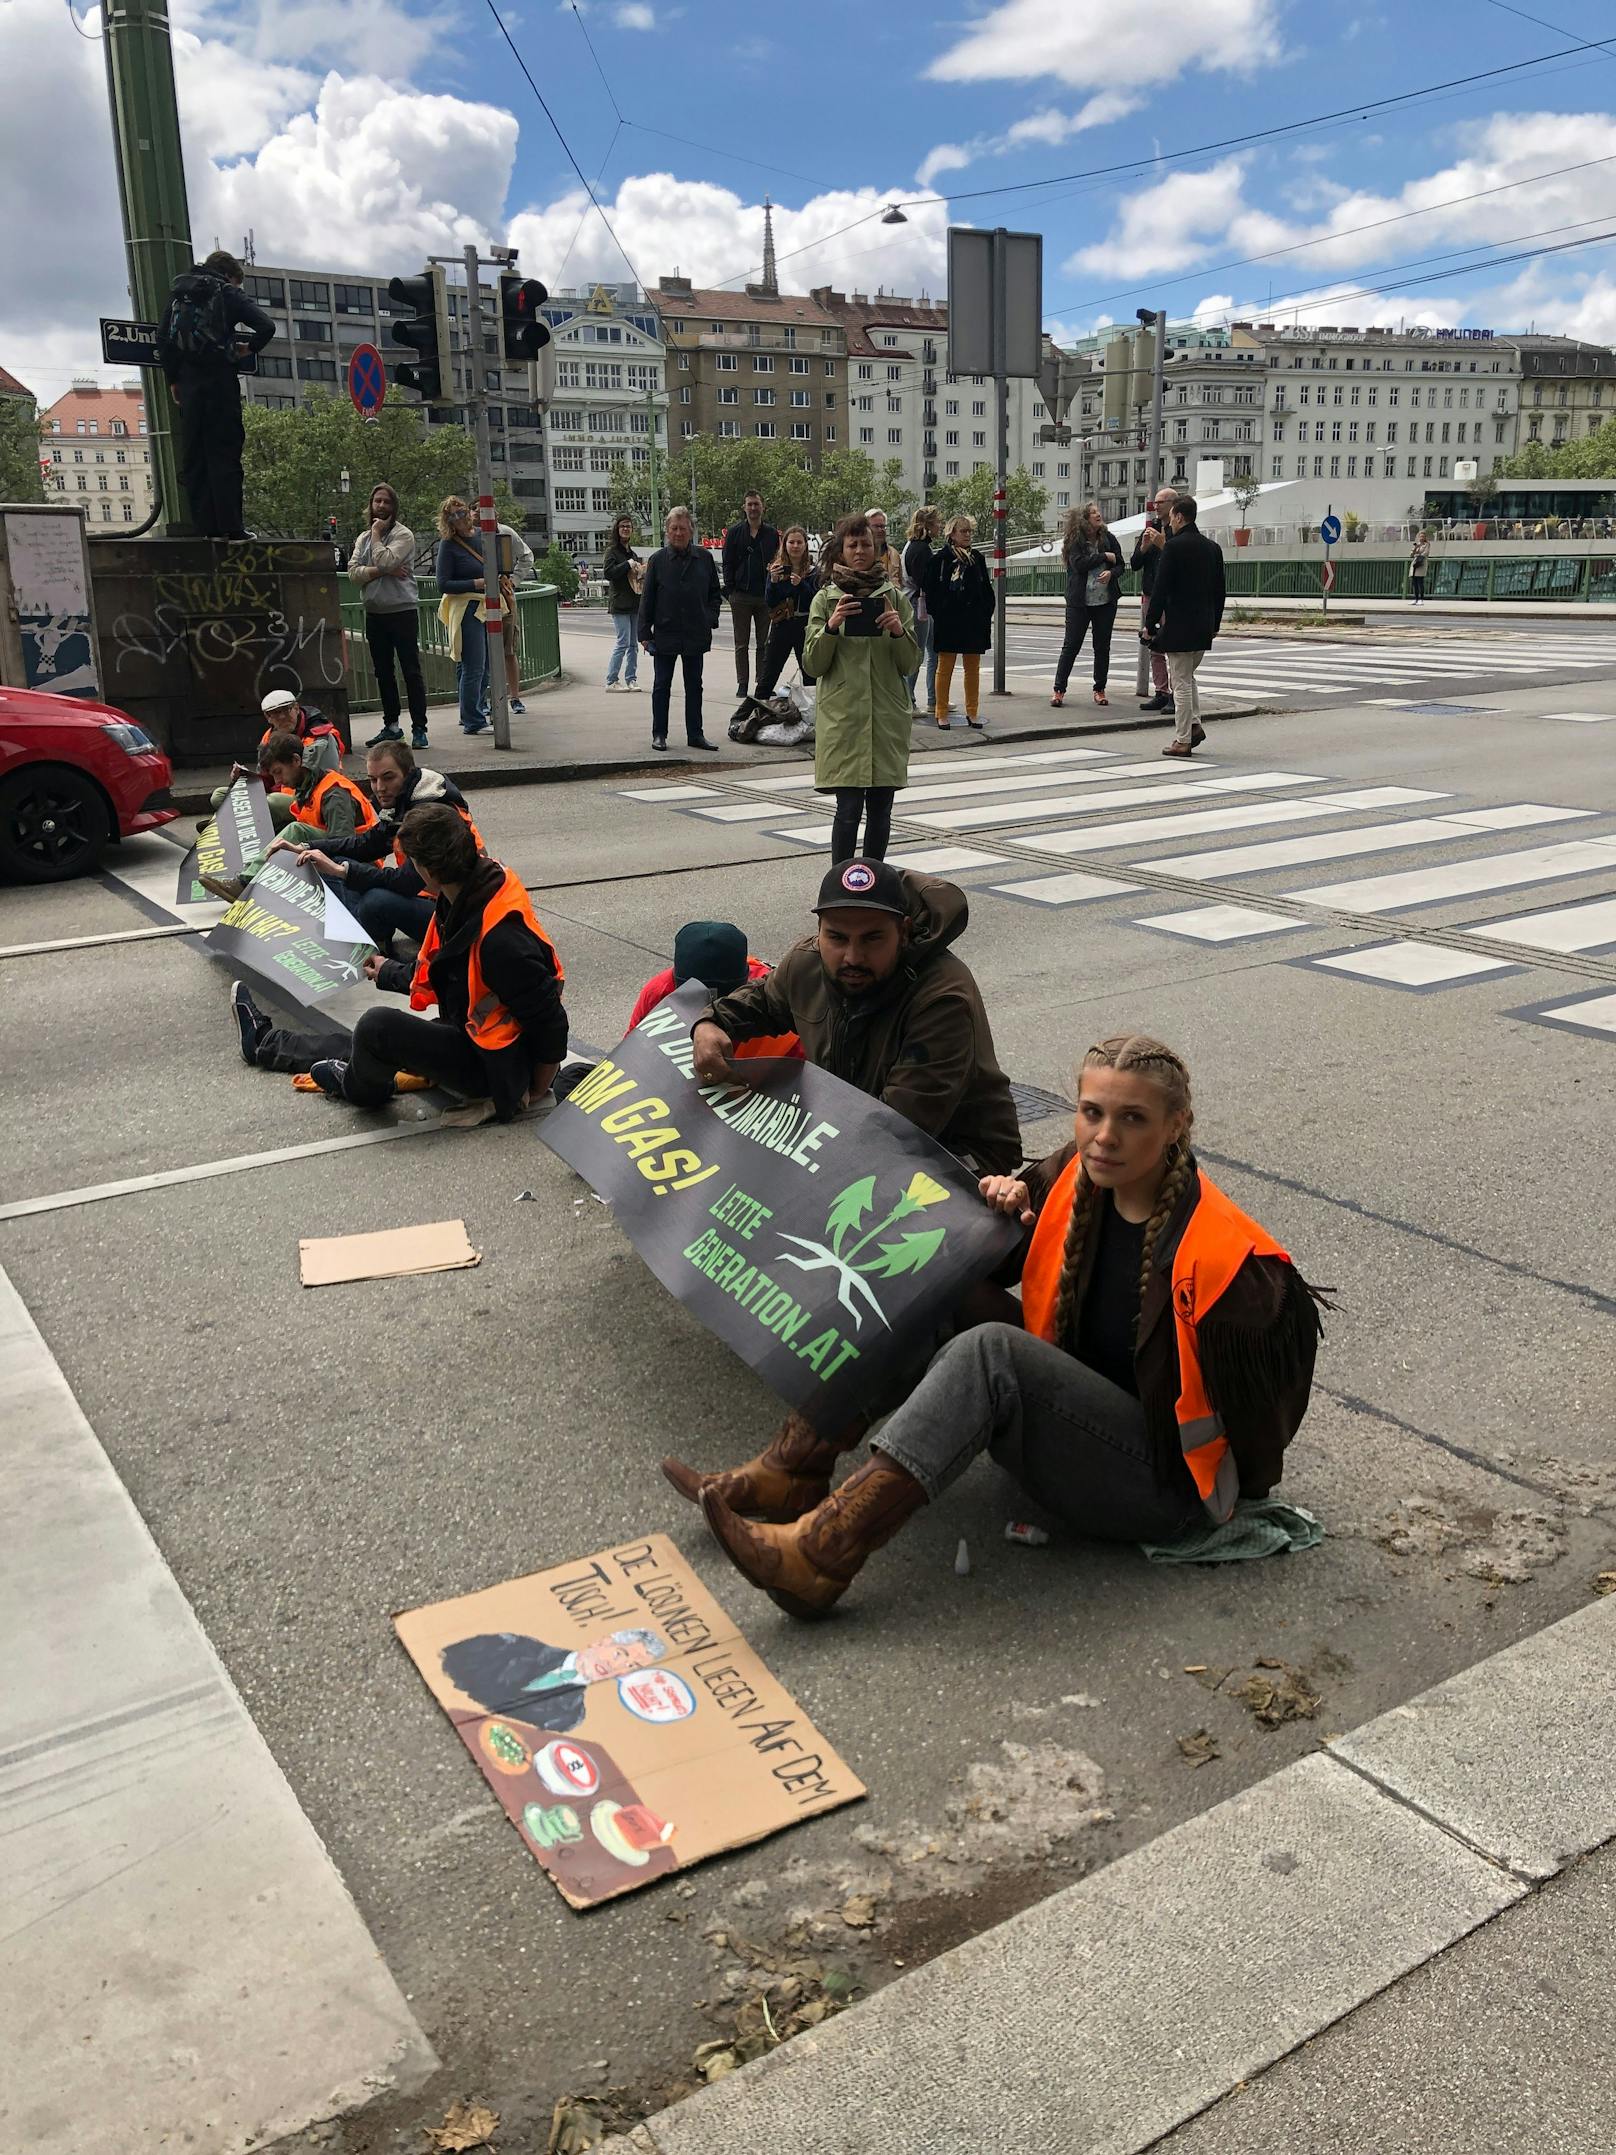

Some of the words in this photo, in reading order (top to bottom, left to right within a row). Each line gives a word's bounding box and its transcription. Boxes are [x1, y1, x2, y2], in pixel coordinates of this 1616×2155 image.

[1436, 328, 1494, 341] HYUNDAI
[281, 879, 314, 904] DIE
[636, 1006, 687, 1038] IN
[600, 1097, 721, 1196] GAS!
[708, 1183, 774, 1240] LETZTE
[682, 1227, 861, 1382] GENERATION.AT
[550, 1561, 639, 1628] TISCH!
[692, 1652, 766, 1721] LIEGEN
[737, 1719, 804, 1754] AUF
[771, 1753, 838, 1804] DEM
